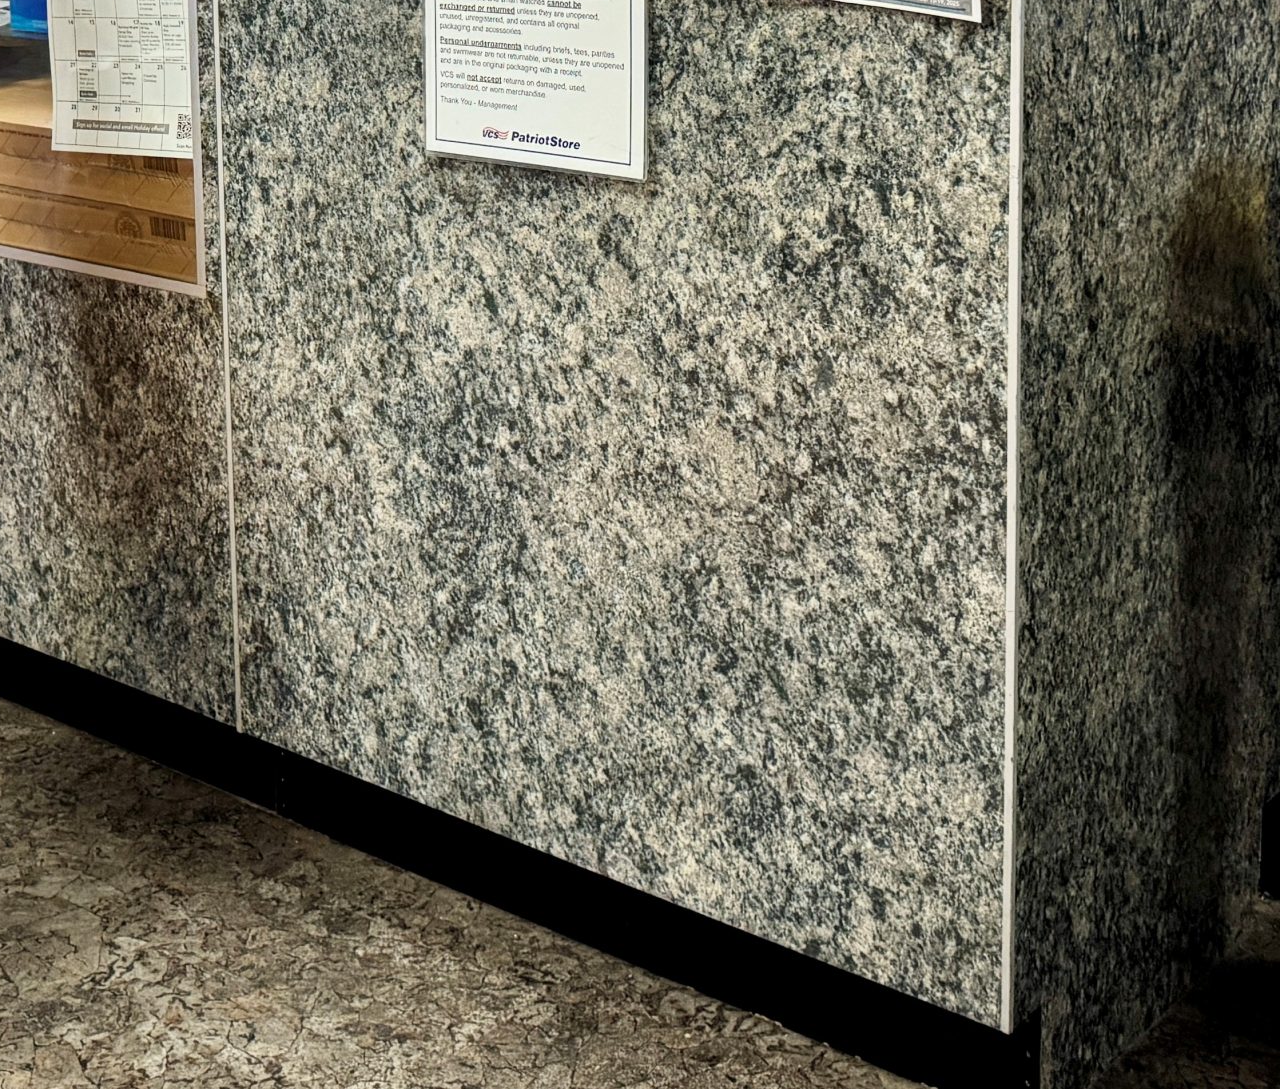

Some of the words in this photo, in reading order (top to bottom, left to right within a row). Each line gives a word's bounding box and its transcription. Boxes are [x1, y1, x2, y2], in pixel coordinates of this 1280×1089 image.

[440, 36, 469, 46] Personal
[441, 96, 459, 104] Thank
[482, 128, 499, 139] VCS
[512, 132, 580, 150] PatriotStore
